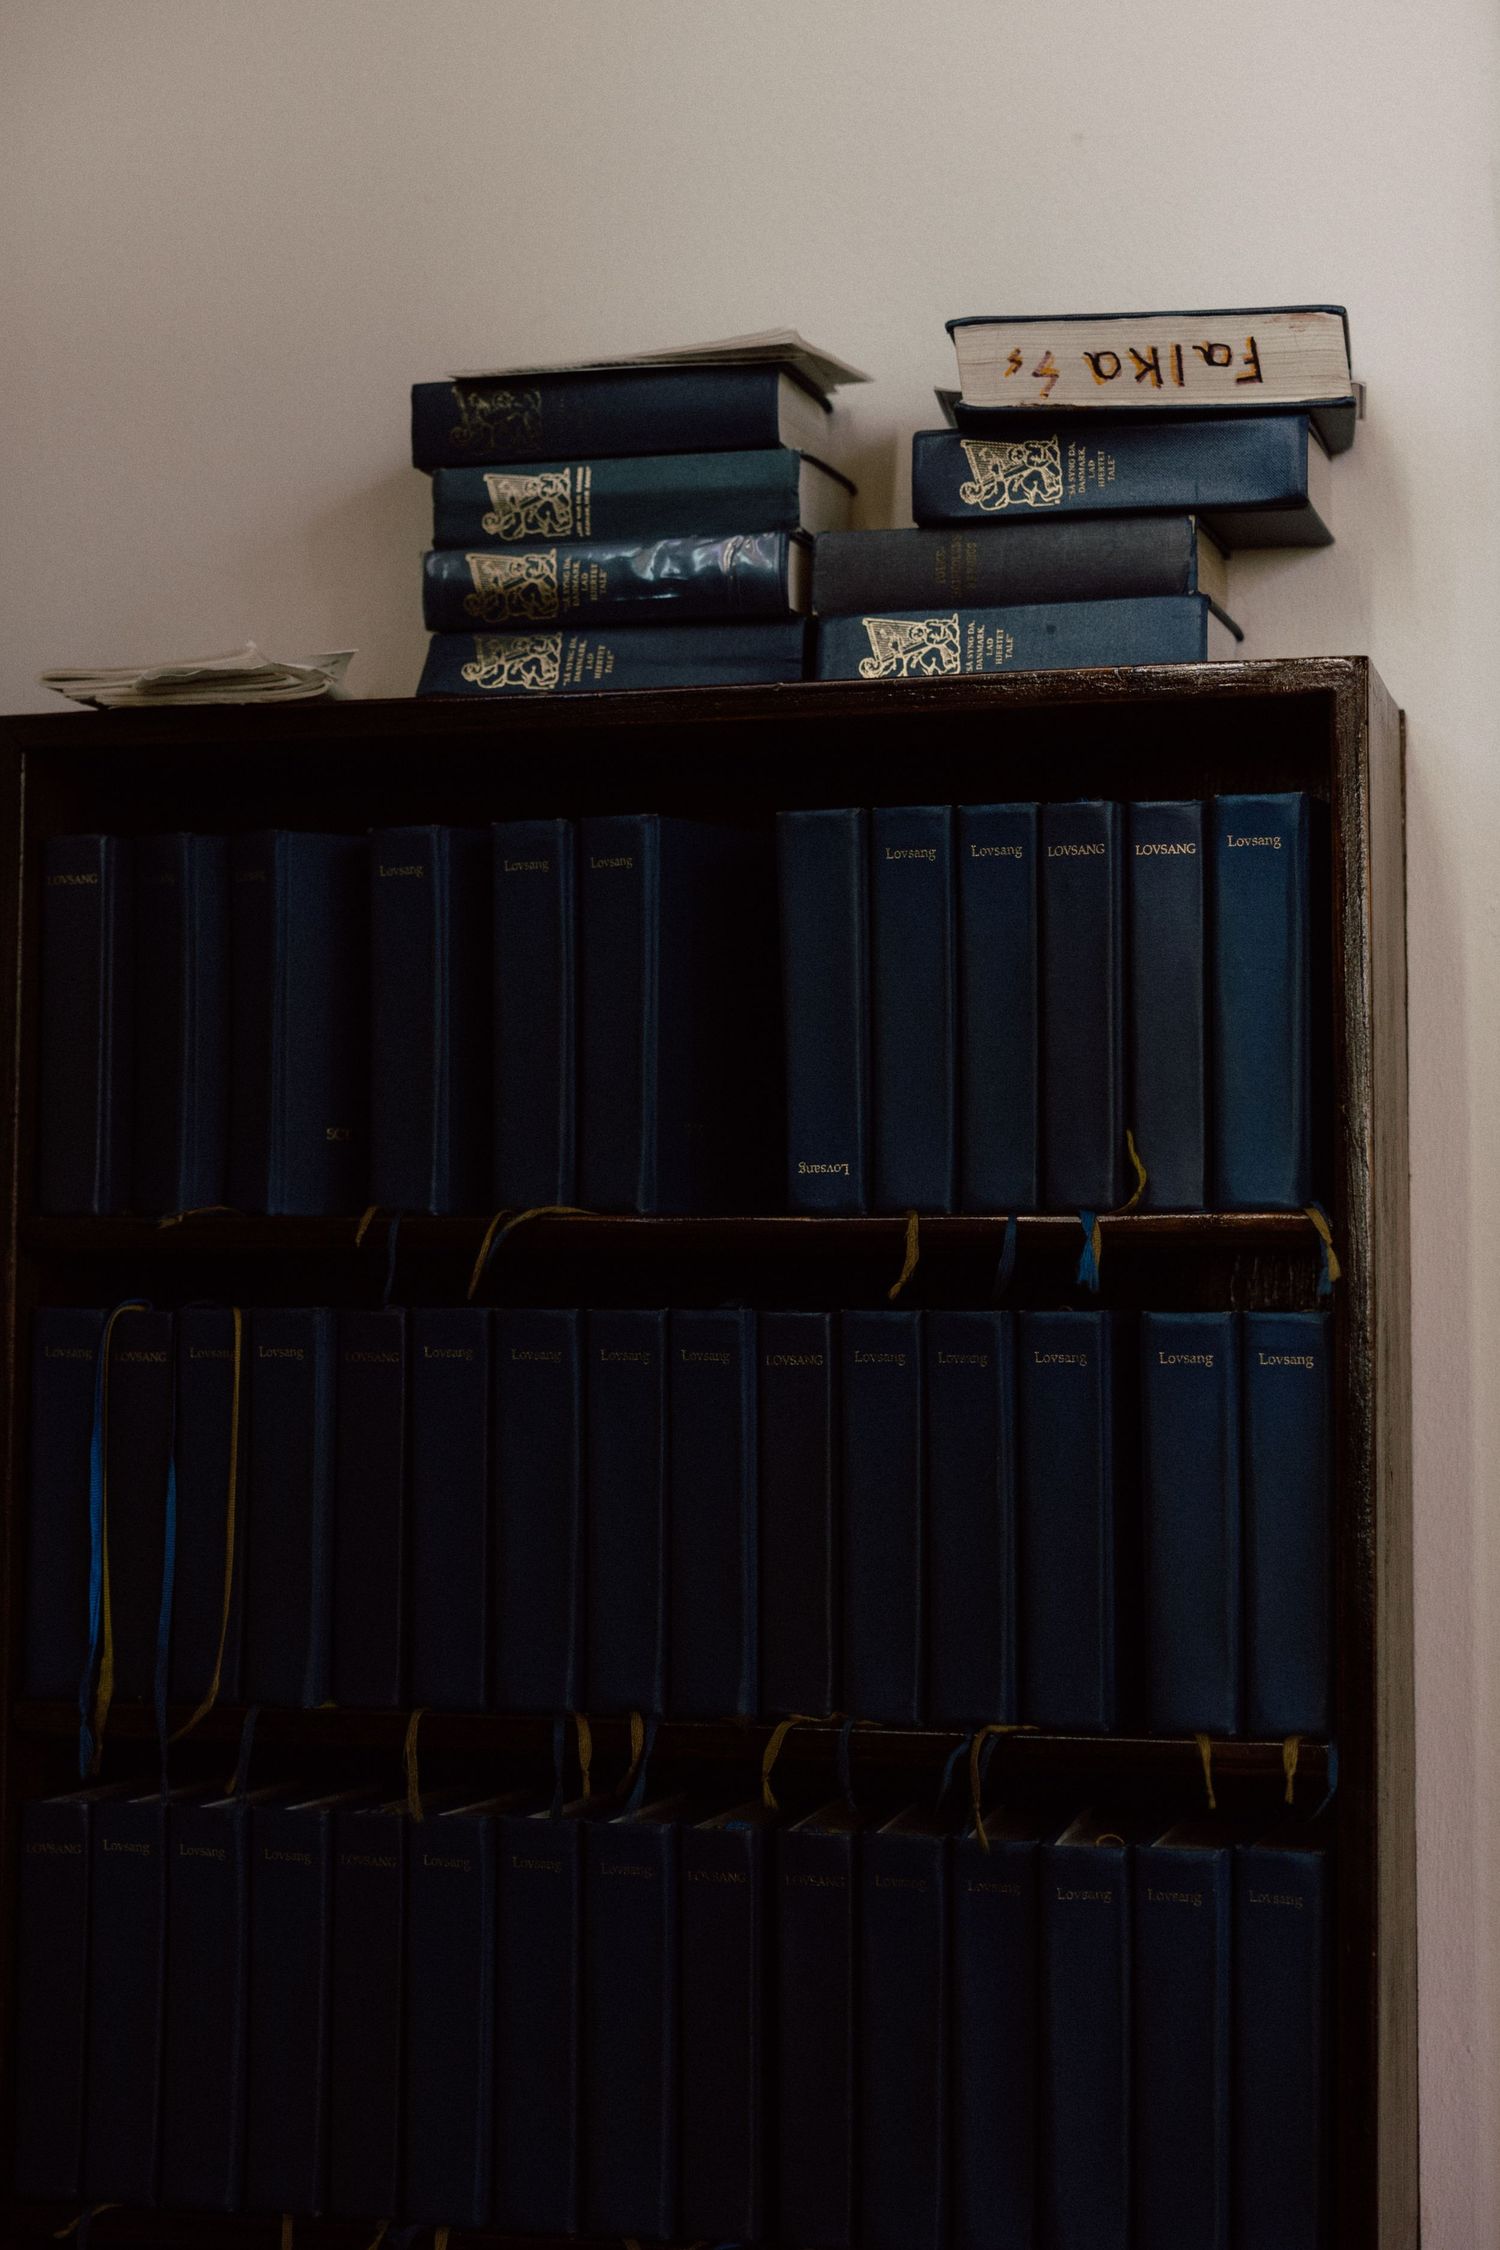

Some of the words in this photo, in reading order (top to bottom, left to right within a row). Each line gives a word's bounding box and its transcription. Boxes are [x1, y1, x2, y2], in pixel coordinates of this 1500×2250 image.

[1083, 336, 1264, 389] Falka
[1067, 458, 1076, 482] SYNG
[1097, 450, 1105, 488] HJERTET
[967, 636, 975, 659] SYNG
[986, 637, 994, 657] LAD
[995, 628, 1004, 665] HJERTET
[1135, 843, 1196, 856] LOVSANG
[1227, 835, 1282, 849] Lovsang
[885, 848, 937, 861] Lovsang
[970, 844, 1023, 859] Lovsang
[1048, 843, 1105, 857] LOVSANG
[504, 859, 549, 873] Lovsang
[590, 856, 633, 869] Lovsang
[378, 864, 425, 878] Lovsang
[798, 1161, 850, 1175] Lovsang
[259, 1345, 305, 1360] Lovsang
[423, 1346, 474, 1360] Lovsang
[600, 1349, 650, 1364] Lovsang
[681, 1349, 731, 1364] Lovsang
[766, 1353, 824, 1366] LOVSANG
[854, 1351, 906, 1366] Lovsang
[1034, 1351, 1088, 1366] Lovsang
[1158, 1352, 1214, 1367] Lovsang
[1259, 1352, 1315, 1368] Lovsang
[1056, 1887, 1112, 1903] Lovsang
